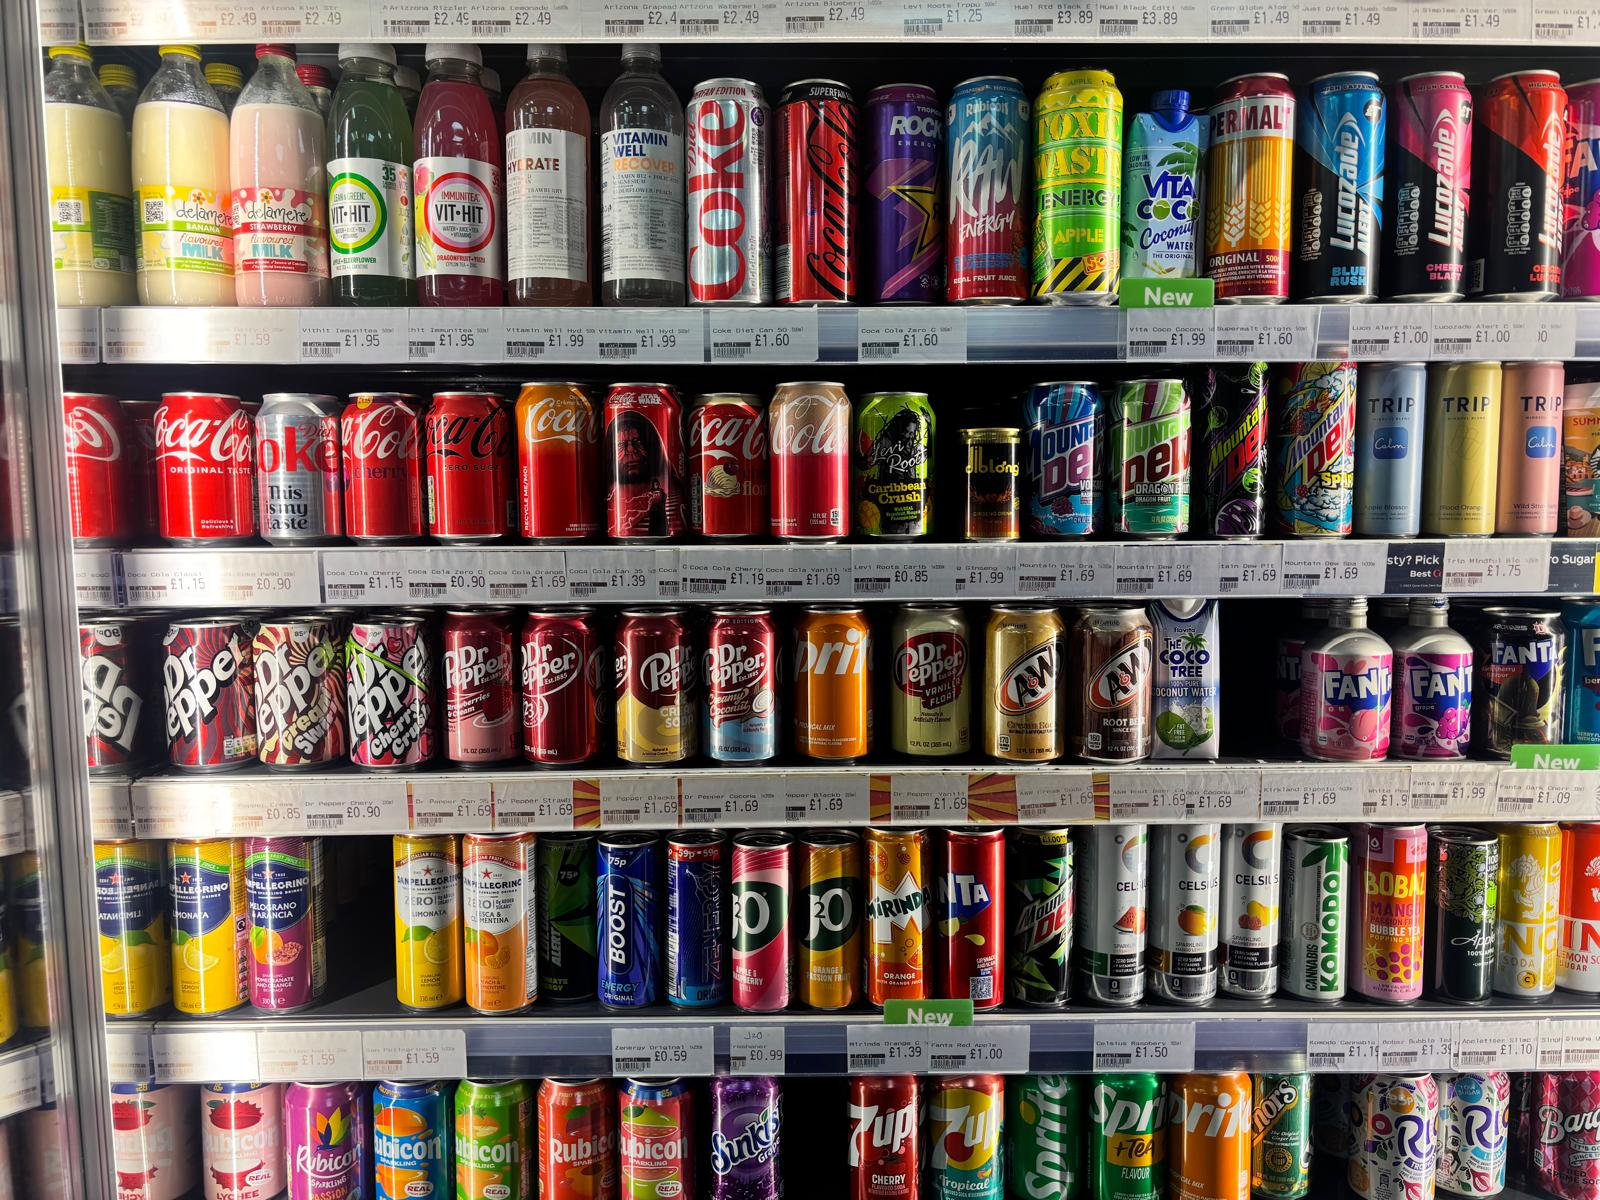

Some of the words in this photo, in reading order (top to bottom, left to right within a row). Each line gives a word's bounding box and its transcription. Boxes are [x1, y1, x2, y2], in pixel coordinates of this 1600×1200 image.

[221, 12, 257, 26] £2.49
[304, 12, 342, 25] £2.49
[515, 12, 551, 25] £2.49
[724, 11, 760, 24] £2.49
[829, 8, 865, 21] £2.49
[947, 9, 983, 23] £1.25
[1058, 11, 1093, 24] £3.89
[1142, 11, 1177, 24] £3.89
[1254, 11, 1289, 24] £1.49
[1345, 13, 1380, 26] £1.49
[1465, 14, 1500, 27] £1.49
[713, 88, 746, 98] EDITION
[613, 132, 668, 147] VITAMIN
[898, 140, 937, 149] ENERGY
[613, 145, 647, 157] WELL
[382, 166, 396, 182] 35
[1140, 172, 1197, 199] VITA
[177, 201, 234, 227] delamere
[247, 202, 309, 224] delamere
[1137, 200, 1201, 222] COCO
[186, 222, 221, 233] BANANA
[250, 222, 297, 233] STRAWBERRY
[960, 214, 1016, 243] ENERGY
[1140, 218, 1196, 250] Coconut
[180, 235, 224, 247] flavoured
[251, 235, 296, 245] flavoured
[1054, 227, 1105, 244] APPLE
[1166, 241, 1194, 252] WATER
[1210, 252, 1259, 267] ORIGINAL
[1332, 265, 1367, 276] BLUE
[1426, 263, 1464, 273] CHERRY
[973, 275, 997, 283] FRUIT
[998, 274, 1017, 282] JUICE
[1330, 276, 1367, 287] RUSH
[1144, 286, 1194, 306] New
[345, 334, 380, 347] £1.95
[440, 334, 475, 347] £1.95
[549, 334, 584, 347] £1.99
[641, 334, 676, 348] £1.99
[755, 334, 790, 347] £1.60
[903, 334, 938, 347] £1.60
[1171, 333, 1206, 346] £1.99
[1258, 332, 1293, 346] £1.60
[1394, 331, 1429, 344] £1.00
[1476, 331, 1511, 344] £1.00
[1369, 396, 1415, 413] TRIP
[1443, 396, 1490, 413] TRIP
[1521, 395, 1562, 412] TRIP
[1375, 437, 1408, 451] Calm
[1527, 436, 1556, 450] Calm
[170, 465, 224, 475] ORIGINAL
[268, 485, 303, 500] This
[868, 481, 927, 496] Caribbean
[878, 491, 922, 505] Crush
[280, 501, 309, 517] my
[266, 516, 309, 530] taste
[1415, 555, 1440, 565] Pick
[1562, 554, 1596, 568] Sugar
[894, 570, 929, 583] £0.85
[970, 570, 1004, 584] £1.99
[1060, 569, 1095, 582] £1.69
[1158, 569, 1192, 582] £1.69
[1243, 568, 1277, 581] £1.69
[1324, 566, 1359, 580] £1.69
[1410, 569, 1432, 579] Best
[1487, 564, 1521, 577] £1.75
[171, 578, 206, 591] £1.15
[256, 577, 291, 591] £0.90
[368, 576, 403, 589] £1.15
[451, 575, 486, 588] £0.90
[531, 575, 566, 588] £1.69
[611, 575, 646, 587] £1.39
[730, 573, 764, 585] £1.19
[806, 573, 840, 586] £1.69
[1164, 638, 1182, 651] THE
[1159, 648, 1211, 665] COCO
[1170, 665, 1203, 678] TREE
[1191, 686, 1217, 697] WATER
[1414, 703, 1436, 712] grape
[1103, 718, 1128, 727] ROOT
[1534, 752, 1579, 770] New
[1060, 792, 1093, 806] £1.69
[1153, 793, 1185, 806] £1.69
[1303, 792, 1336, 805] £1.69
[1451, 787, 1485, 799] £1.99
[1537, 791, 1571, 804] £1.09
[644, 800, 677, 813] £1.69
[725, 800, 758, 812] £1.69
[809, 797, 843, 810] £1.69
[934, 797, 967, 810] £1.69
[1199, 795, 1232, 808] £1.69
[267, 807, 301, 820] £0.85
[347, 807, 380, 819] £0.90
[457, 805, 491, 817] £1.69
[539, 803, 573, 816] £1.69
[608, 857, 626, 870] 75p
[609, 884, 626, 965] BOOST
[1370, 925, 1406, 936] BUBBLE
[1320, 871, 1342, 992] KOMODO
[1305, 944, 1319, 992] CANNABIS
[884, 971, 916, 980] ORANGE
[601, 980, 638, 993] ENERGY
[604, 993, 635, 1001] ORIGINAL
[906, 1008, 954, 1027] New
[654, 1050, 687, 1062] £0.59
[750, 1049, 783, 1062] £0.99
[889, 1046, 923, 1059] £1.39
[970, 1047, 1002, 1060] £1.00
[1135, 1046, 1168, 1058] £1.50
[1500, 1043, 1533, 1056] £1.10
[302, 1054, 336, 1067] £1.59
[406, 1052, 440, 1065] £1.59
[380, 1157, 417, 1168] SPARKLING
[247, 1172, 272, 1182] REAL
[872, 1174, 906, 1185] CHERRY
[1121, 1167, 1150, 1180] FLAVOUR
[311, 1175, 348, 1190] SPARKLING
[406, 1184, 431, 1195] REAL
[484, 1187, 509, 1197] REAL
